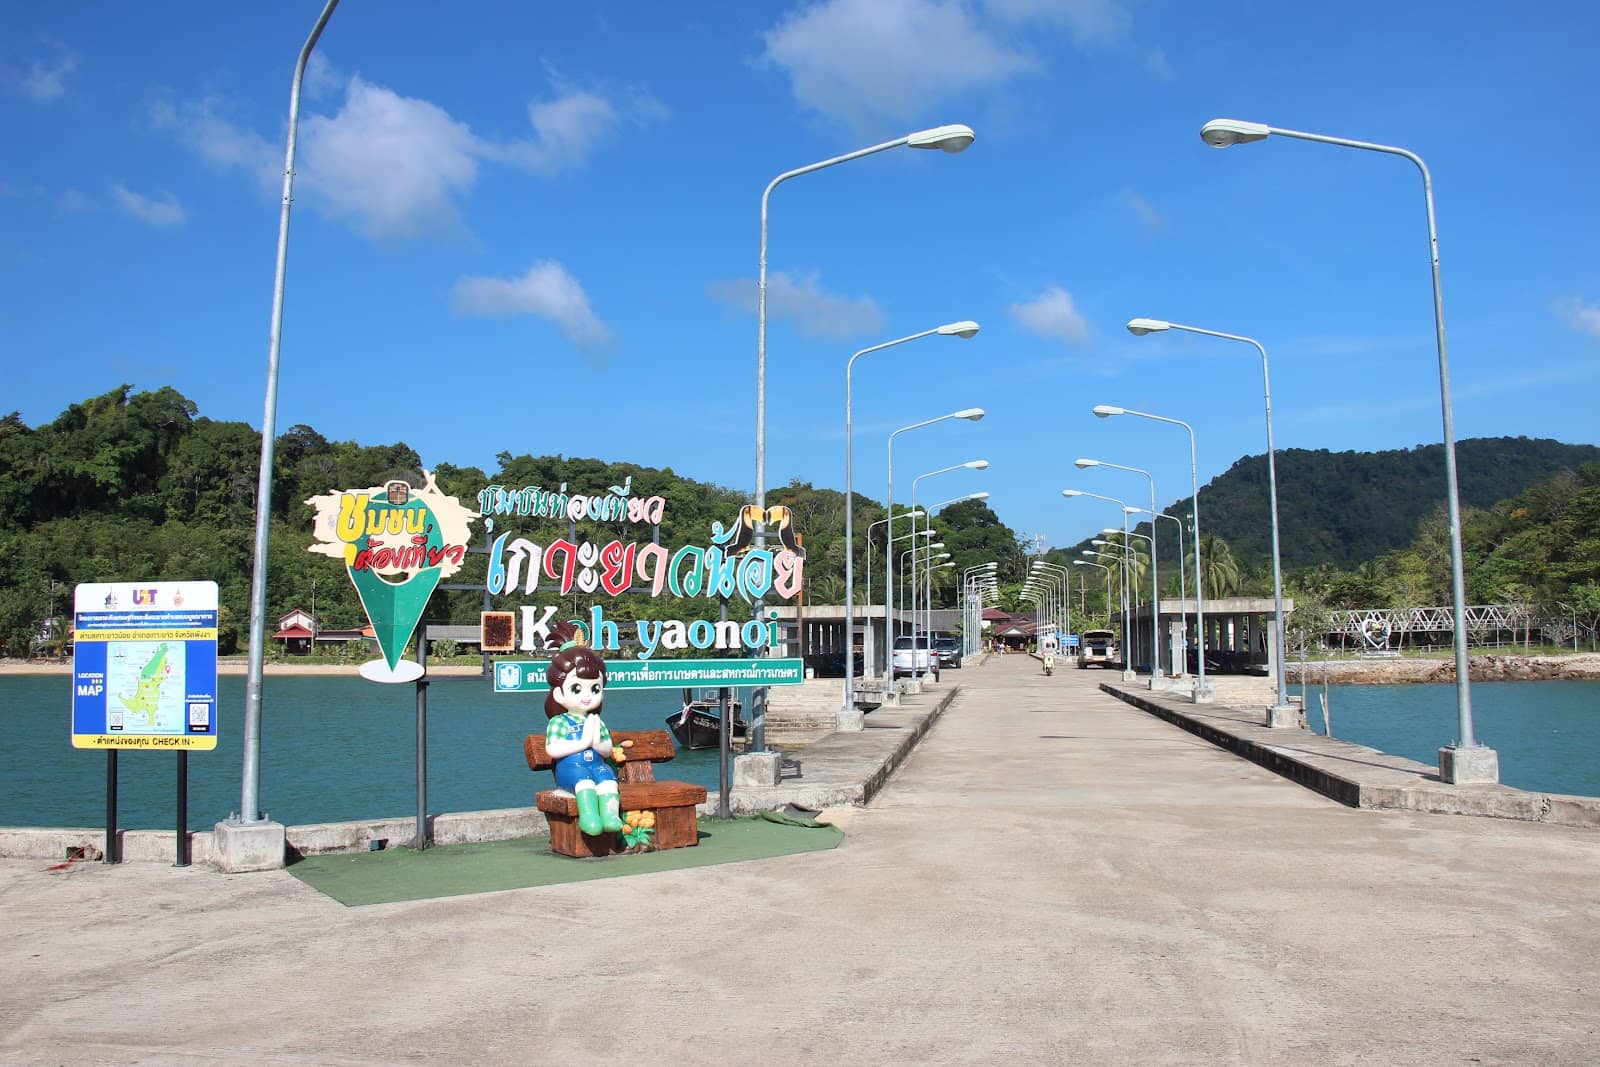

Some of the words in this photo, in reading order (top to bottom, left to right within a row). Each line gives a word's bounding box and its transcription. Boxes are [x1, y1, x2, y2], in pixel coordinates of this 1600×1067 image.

[478, 476, 665, 533] ชุมชนท่องเที่ยว
[336, 493, 427, 566] ชุมชน
[353, 524, 465, 571] ต้องเที่ยว
[487, 521, 805, 605] เกาะยาวน้อย
[637, 611, 779, 659] yaonoi
[78, 685, 104, 696] MAP
[606, 663, 798, 682] นาคารเพื่อการเกษตรและสหกรณ์การเกษตร
[97, 736, 149, 748] ตำแหน่งของคุณ
[152, 738, 179, 746] CHECK
[181, 738, 191, 746] IN
